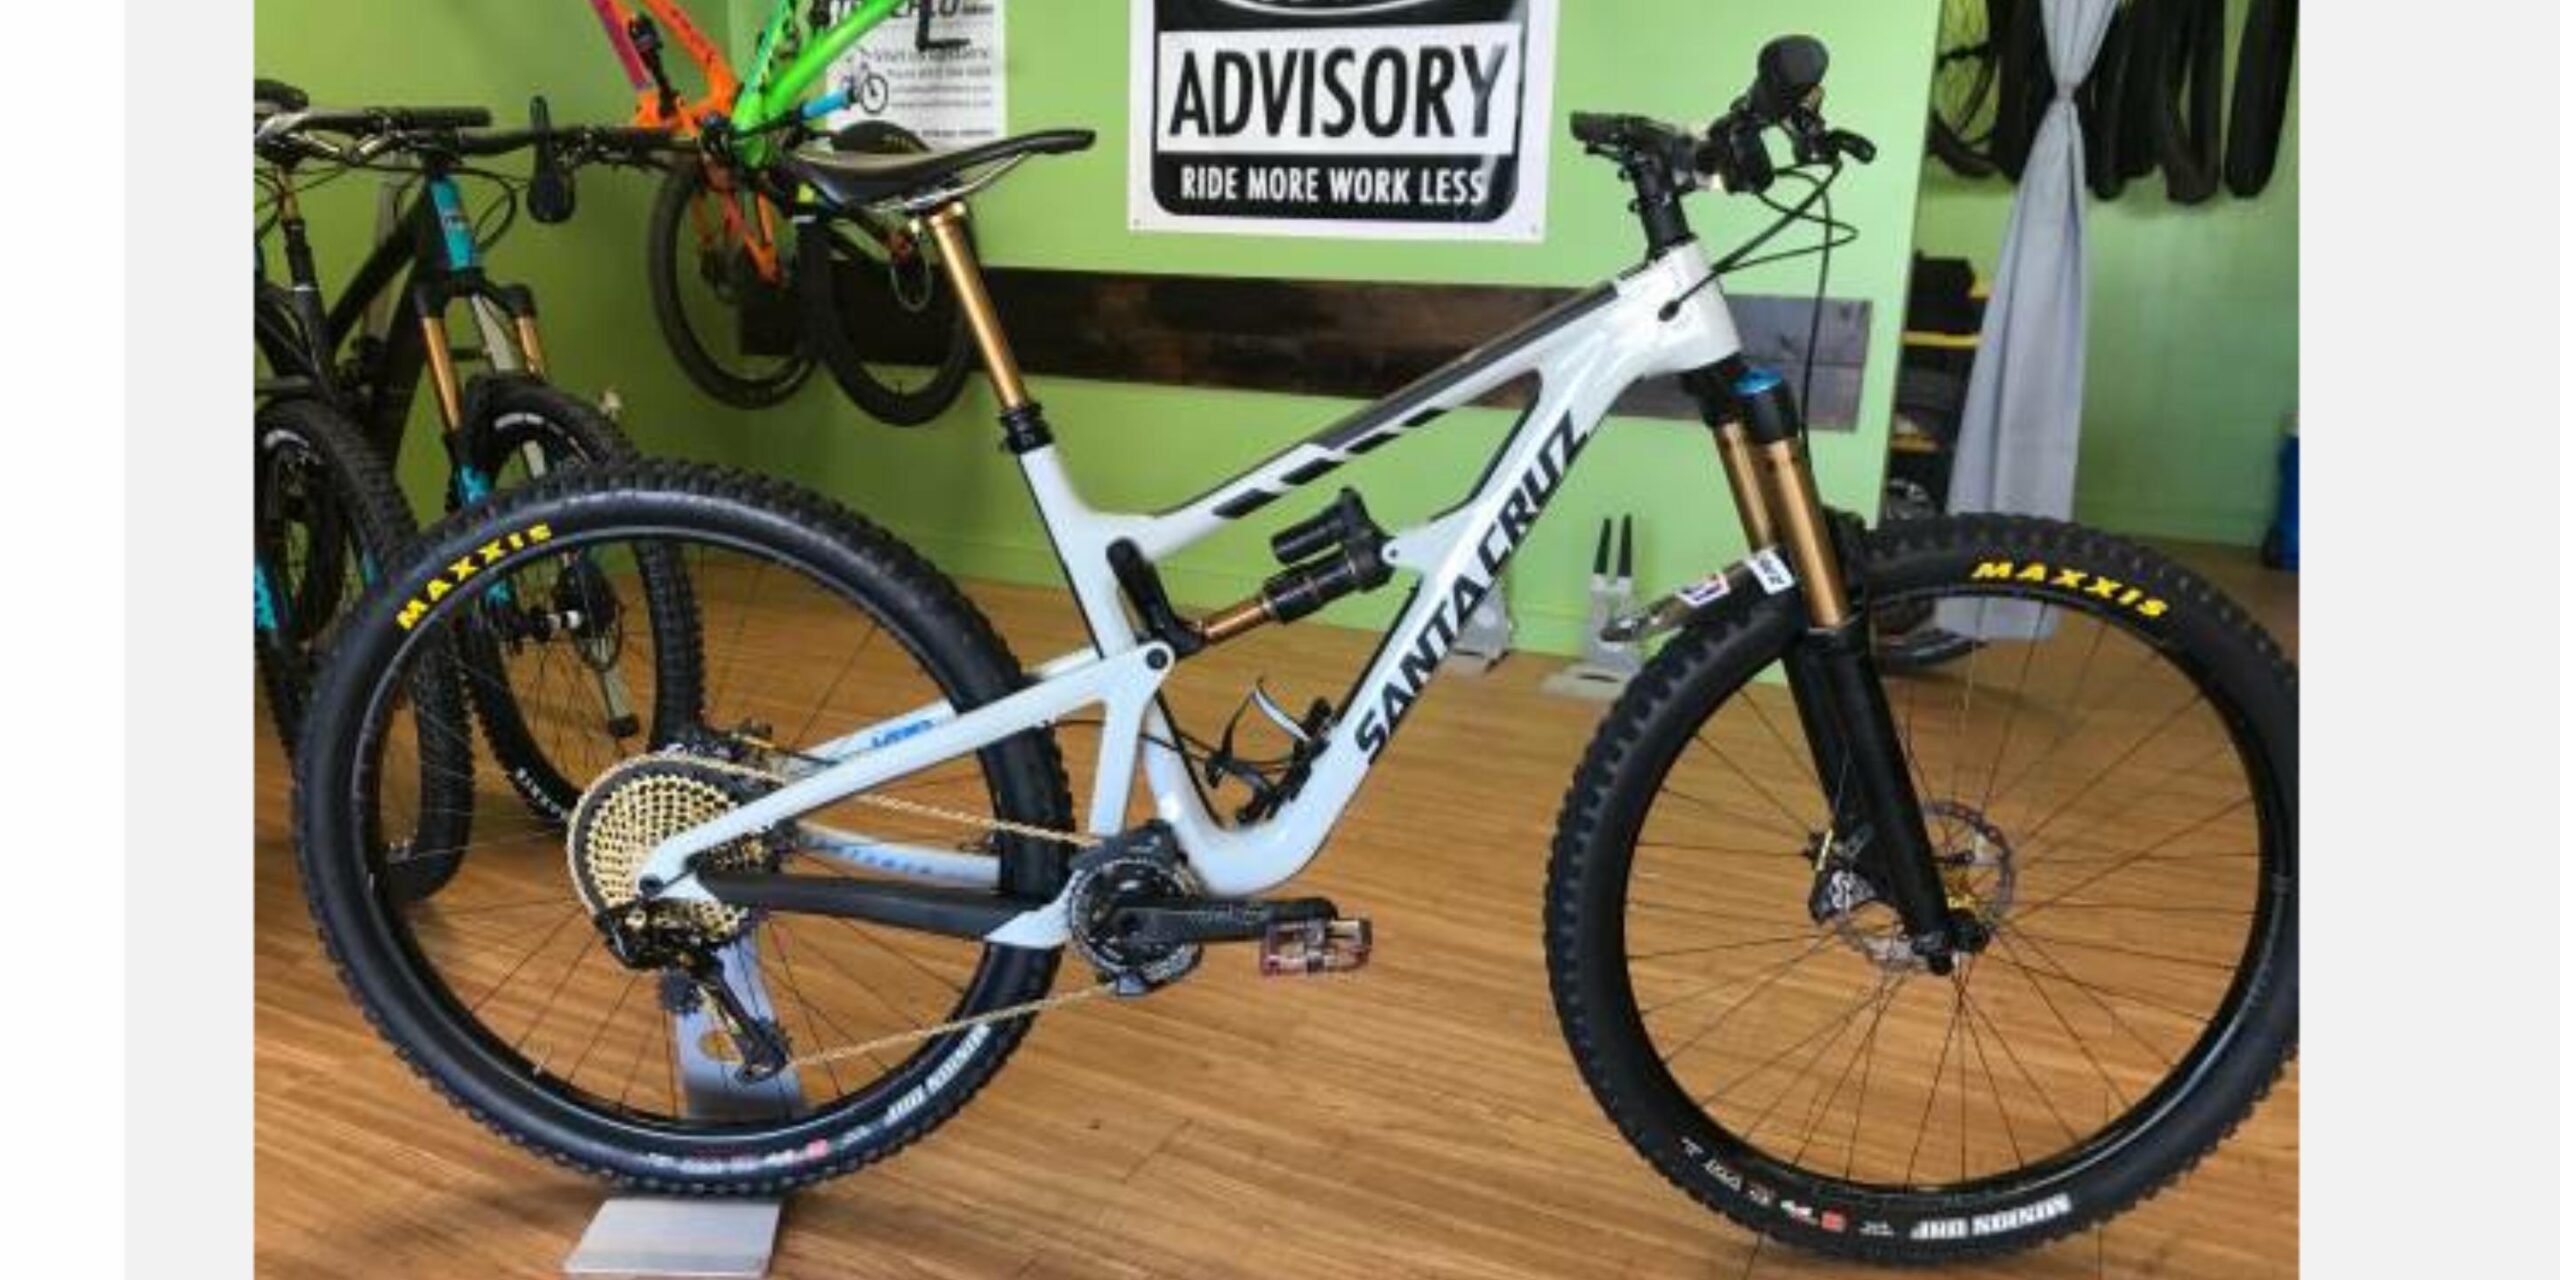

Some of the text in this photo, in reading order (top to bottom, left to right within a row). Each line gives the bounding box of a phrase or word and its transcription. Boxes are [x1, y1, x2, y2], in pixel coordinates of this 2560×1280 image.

[1168, 45, 1508, 138] ADVISORY
[1180, 165, 1486, 206] RIDE MORE WORK LESS
[396, 523, 552, 630] MAXXIS
[1354, 409, 1588, 767] SANTA CRUZ
[1971, 561, 2169, 618] MAXXIS
